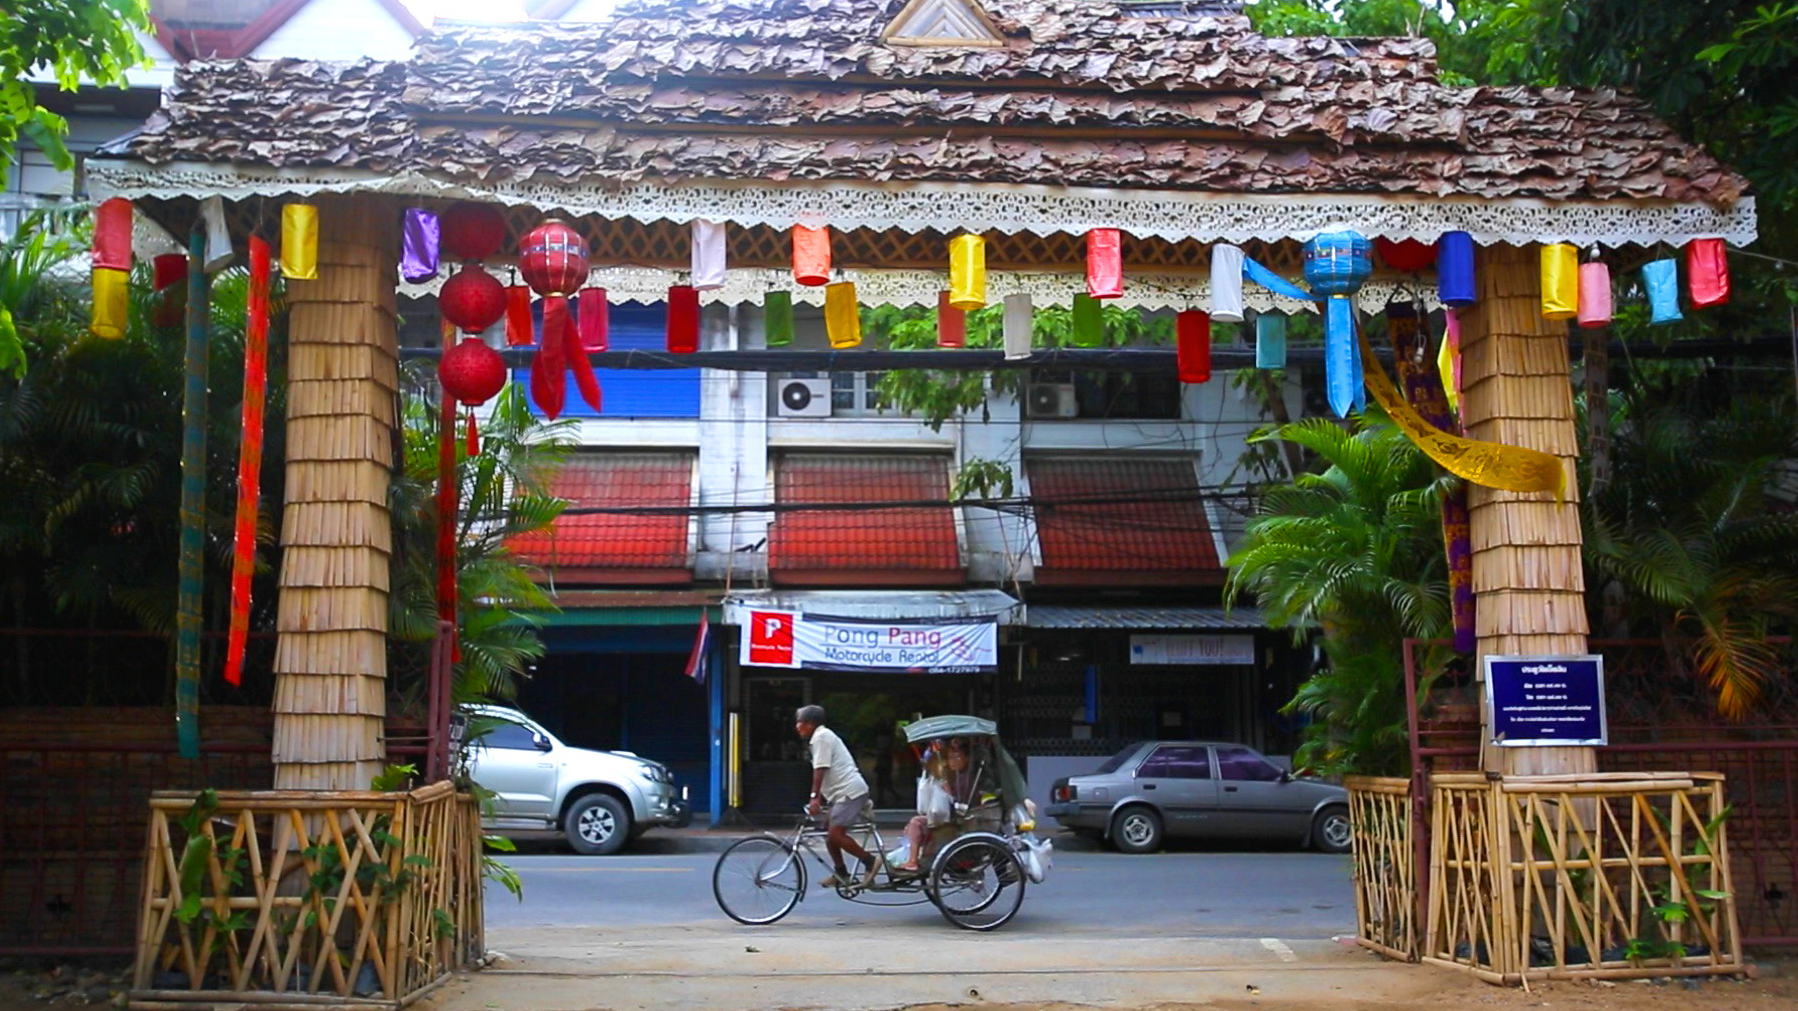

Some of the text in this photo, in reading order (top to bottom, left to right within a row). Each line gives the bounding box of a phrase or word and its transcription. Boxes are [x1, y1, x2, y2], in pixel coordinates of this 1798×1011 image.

[765, 618, 782, 639] P
[825, 625, 942, 650] Pong Pang
[825, 647, 939, 665] Motorcycle Rental
